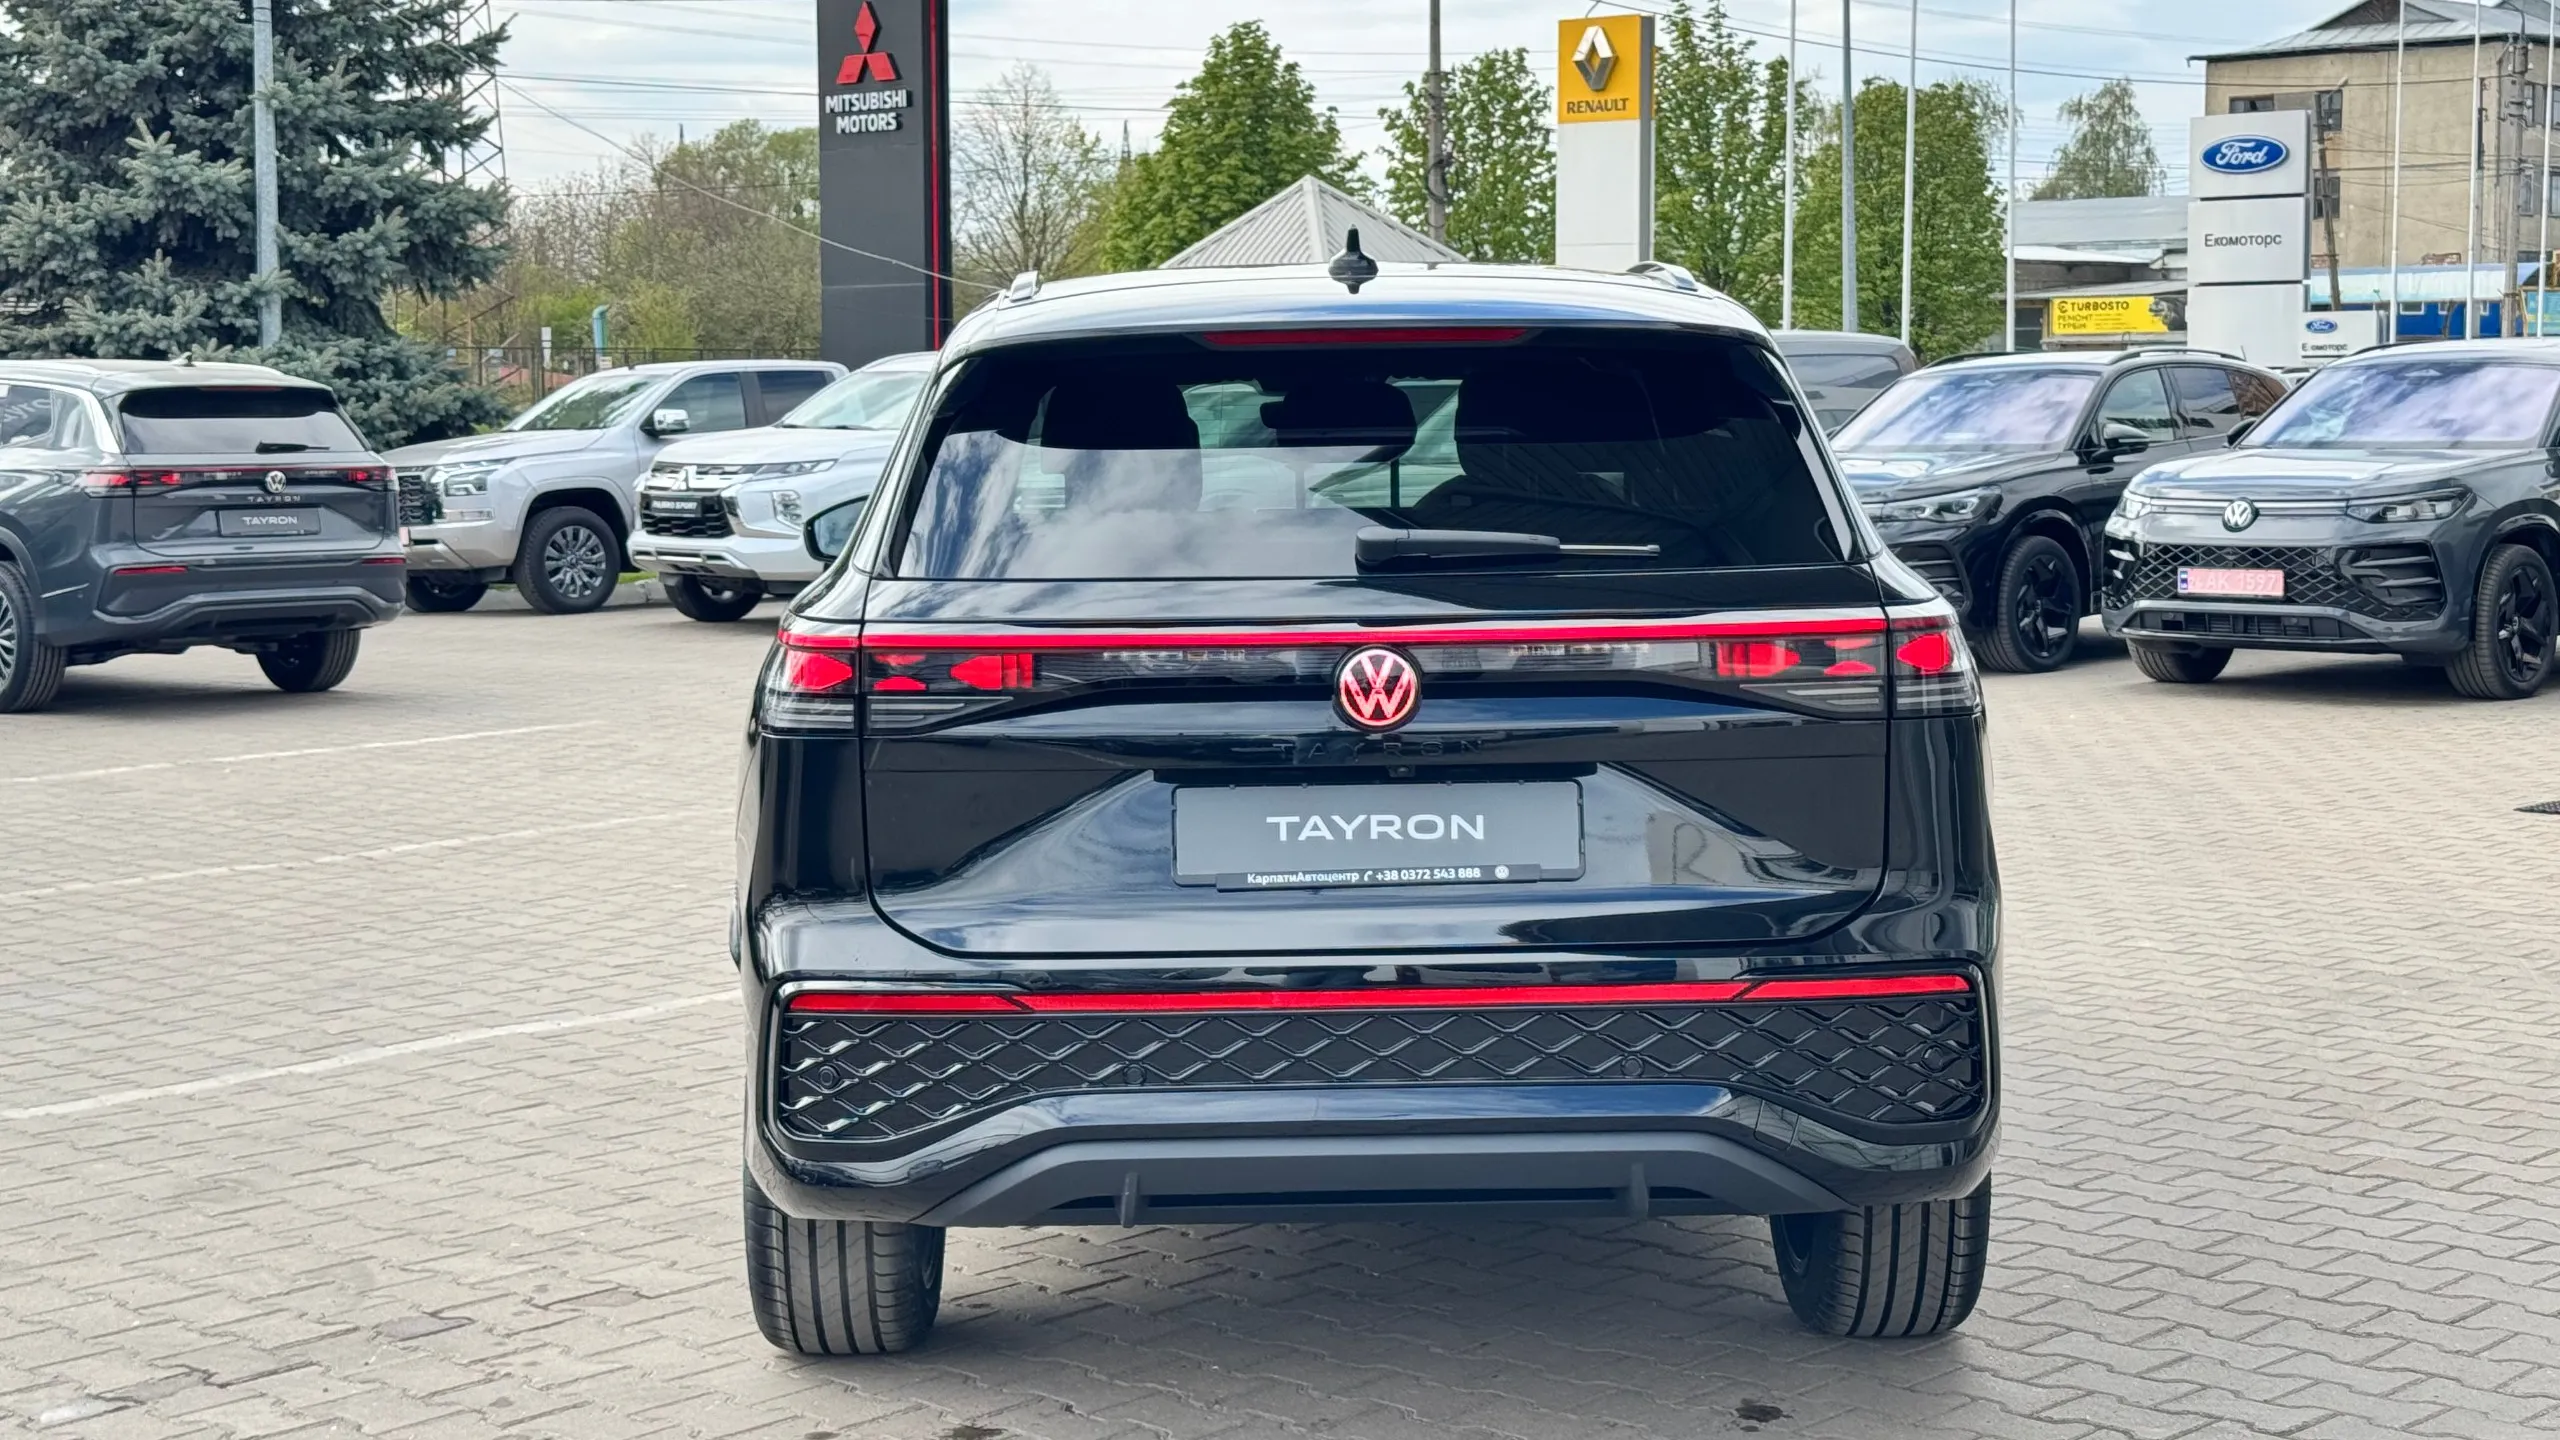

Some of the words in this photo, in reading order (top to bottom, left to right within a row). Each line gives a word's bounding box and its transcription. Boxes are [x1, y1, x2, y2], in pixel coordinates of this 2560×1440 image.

[825, 89, 907, 114] MITSUBISHI
[1566, 98, 1629, 114] RENAULT
[836, 112, 897, 134] MOTORS
[2215, 141, 2269, 165] Ford
[2070, 301, 2129, 312] TURBOSTO
[2310, 320, 2330, 331] Ford
[248, 495, 300, 503] TAYRON
[241, 516, 298, 525] TAYRON
[2237, 573, 2277, 592] 1597
[1272, 739, 1482, 762] TAYRON
[1266, 814, 1485, 842] TAYRON
[1247, 871, 1360, 886] КарпатиАвтоцентр
[1376, 869, 1399, 881] +38
[1400, 869, 1431, 880] 0372
[1433, 868, 1456, 879] 543
[1458, 867, 1481, 878] 888
